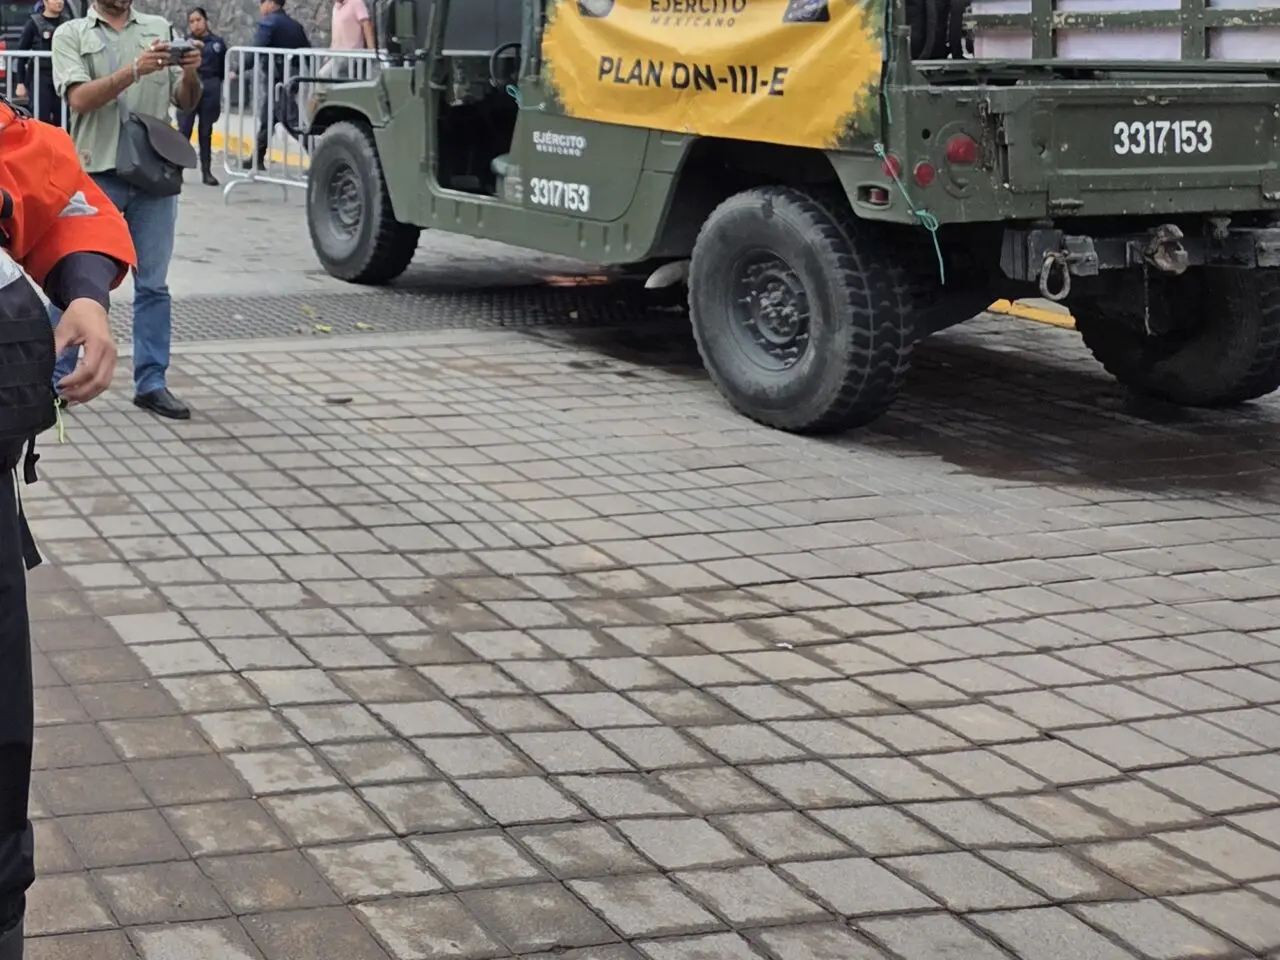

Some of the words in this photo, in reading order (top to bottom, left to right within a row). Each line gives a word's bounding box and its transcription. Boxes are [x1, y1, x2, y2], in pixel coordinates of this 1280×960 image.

[650, 16, 736, 28] MEXICANO
[598, 55, 664, 88] PLAN
[671, 62, 788, 96] DN-III-E
[1114, 120, 1212, 154] 3317153
[530, 177, 590, 212] 3317153
